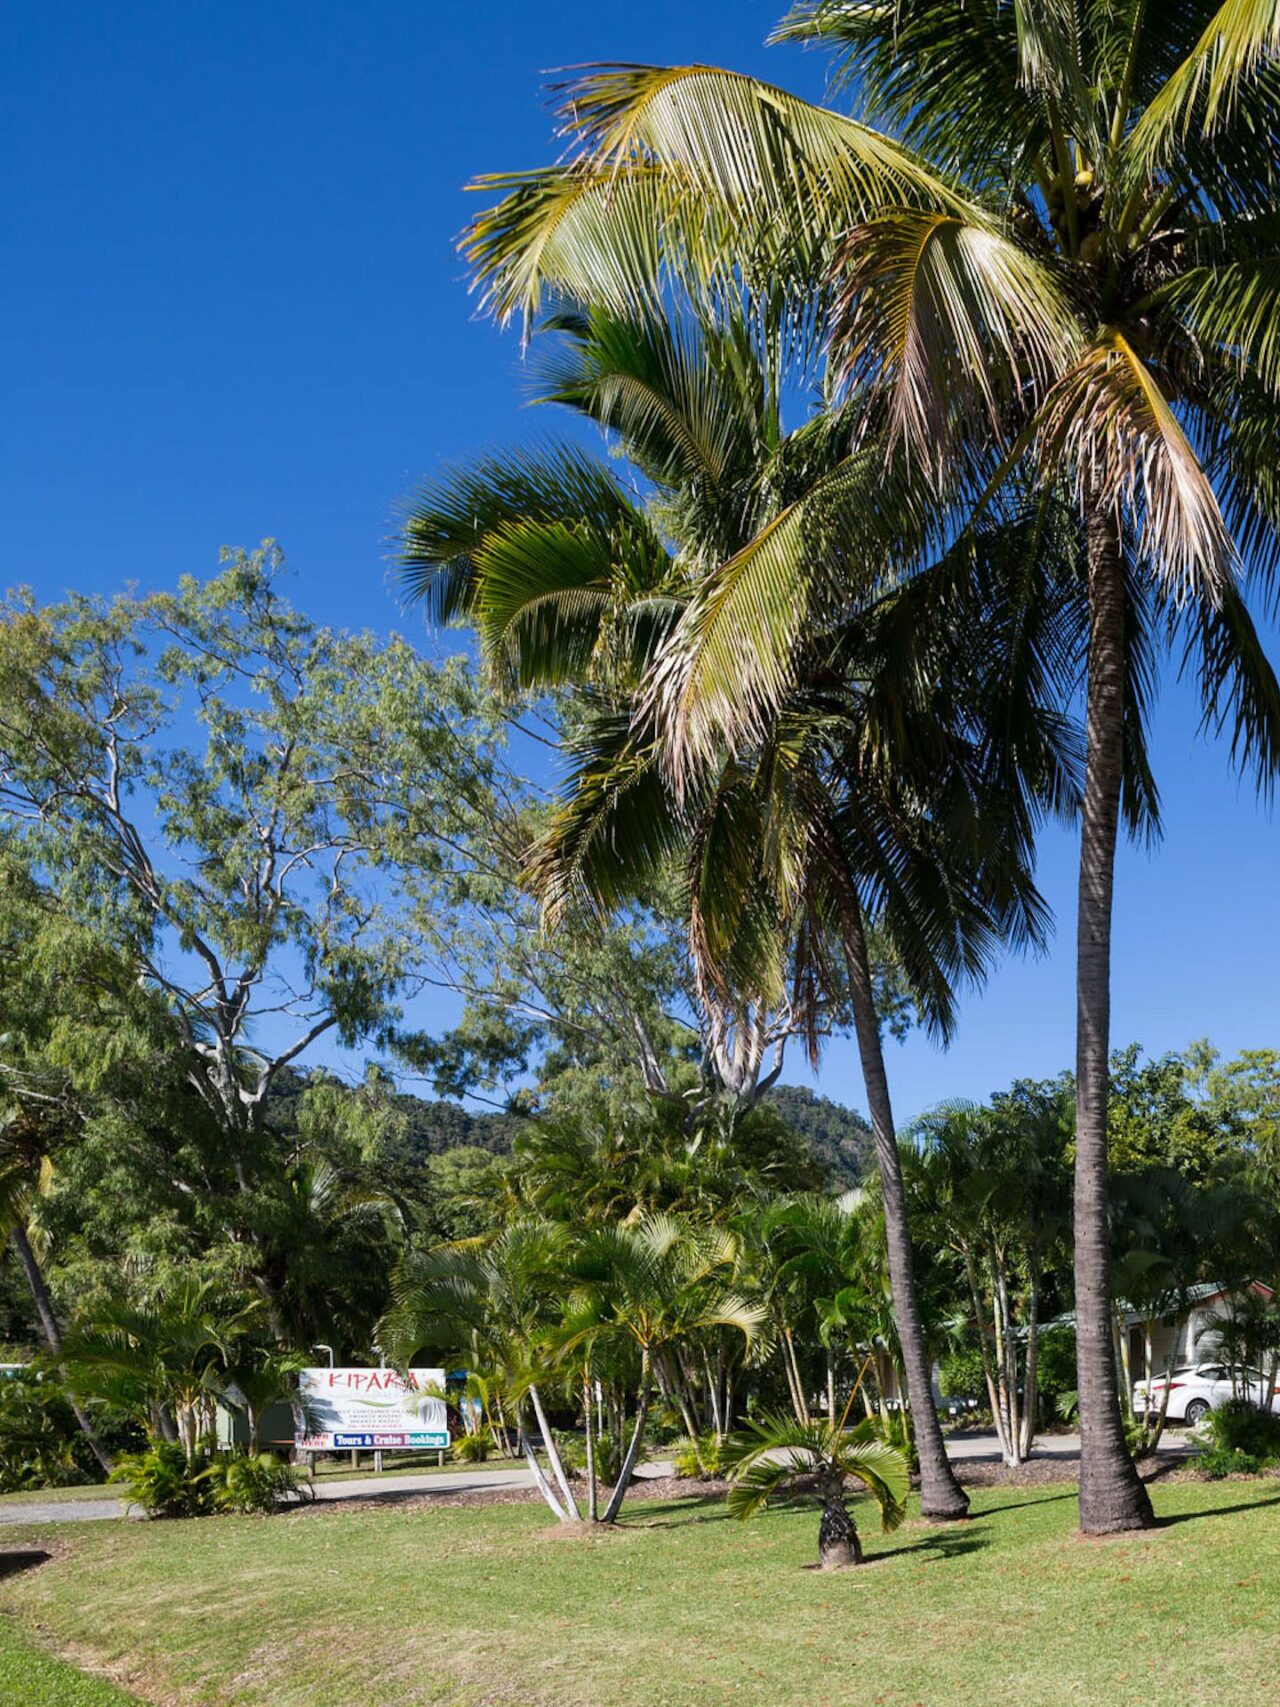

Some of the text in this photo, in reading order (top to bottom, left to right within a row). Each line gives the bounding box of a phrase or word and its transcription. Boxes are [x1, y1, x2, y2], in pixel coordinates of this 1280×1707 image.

[336, 1433, 444, 1447] Tours & Cruise Bookings
